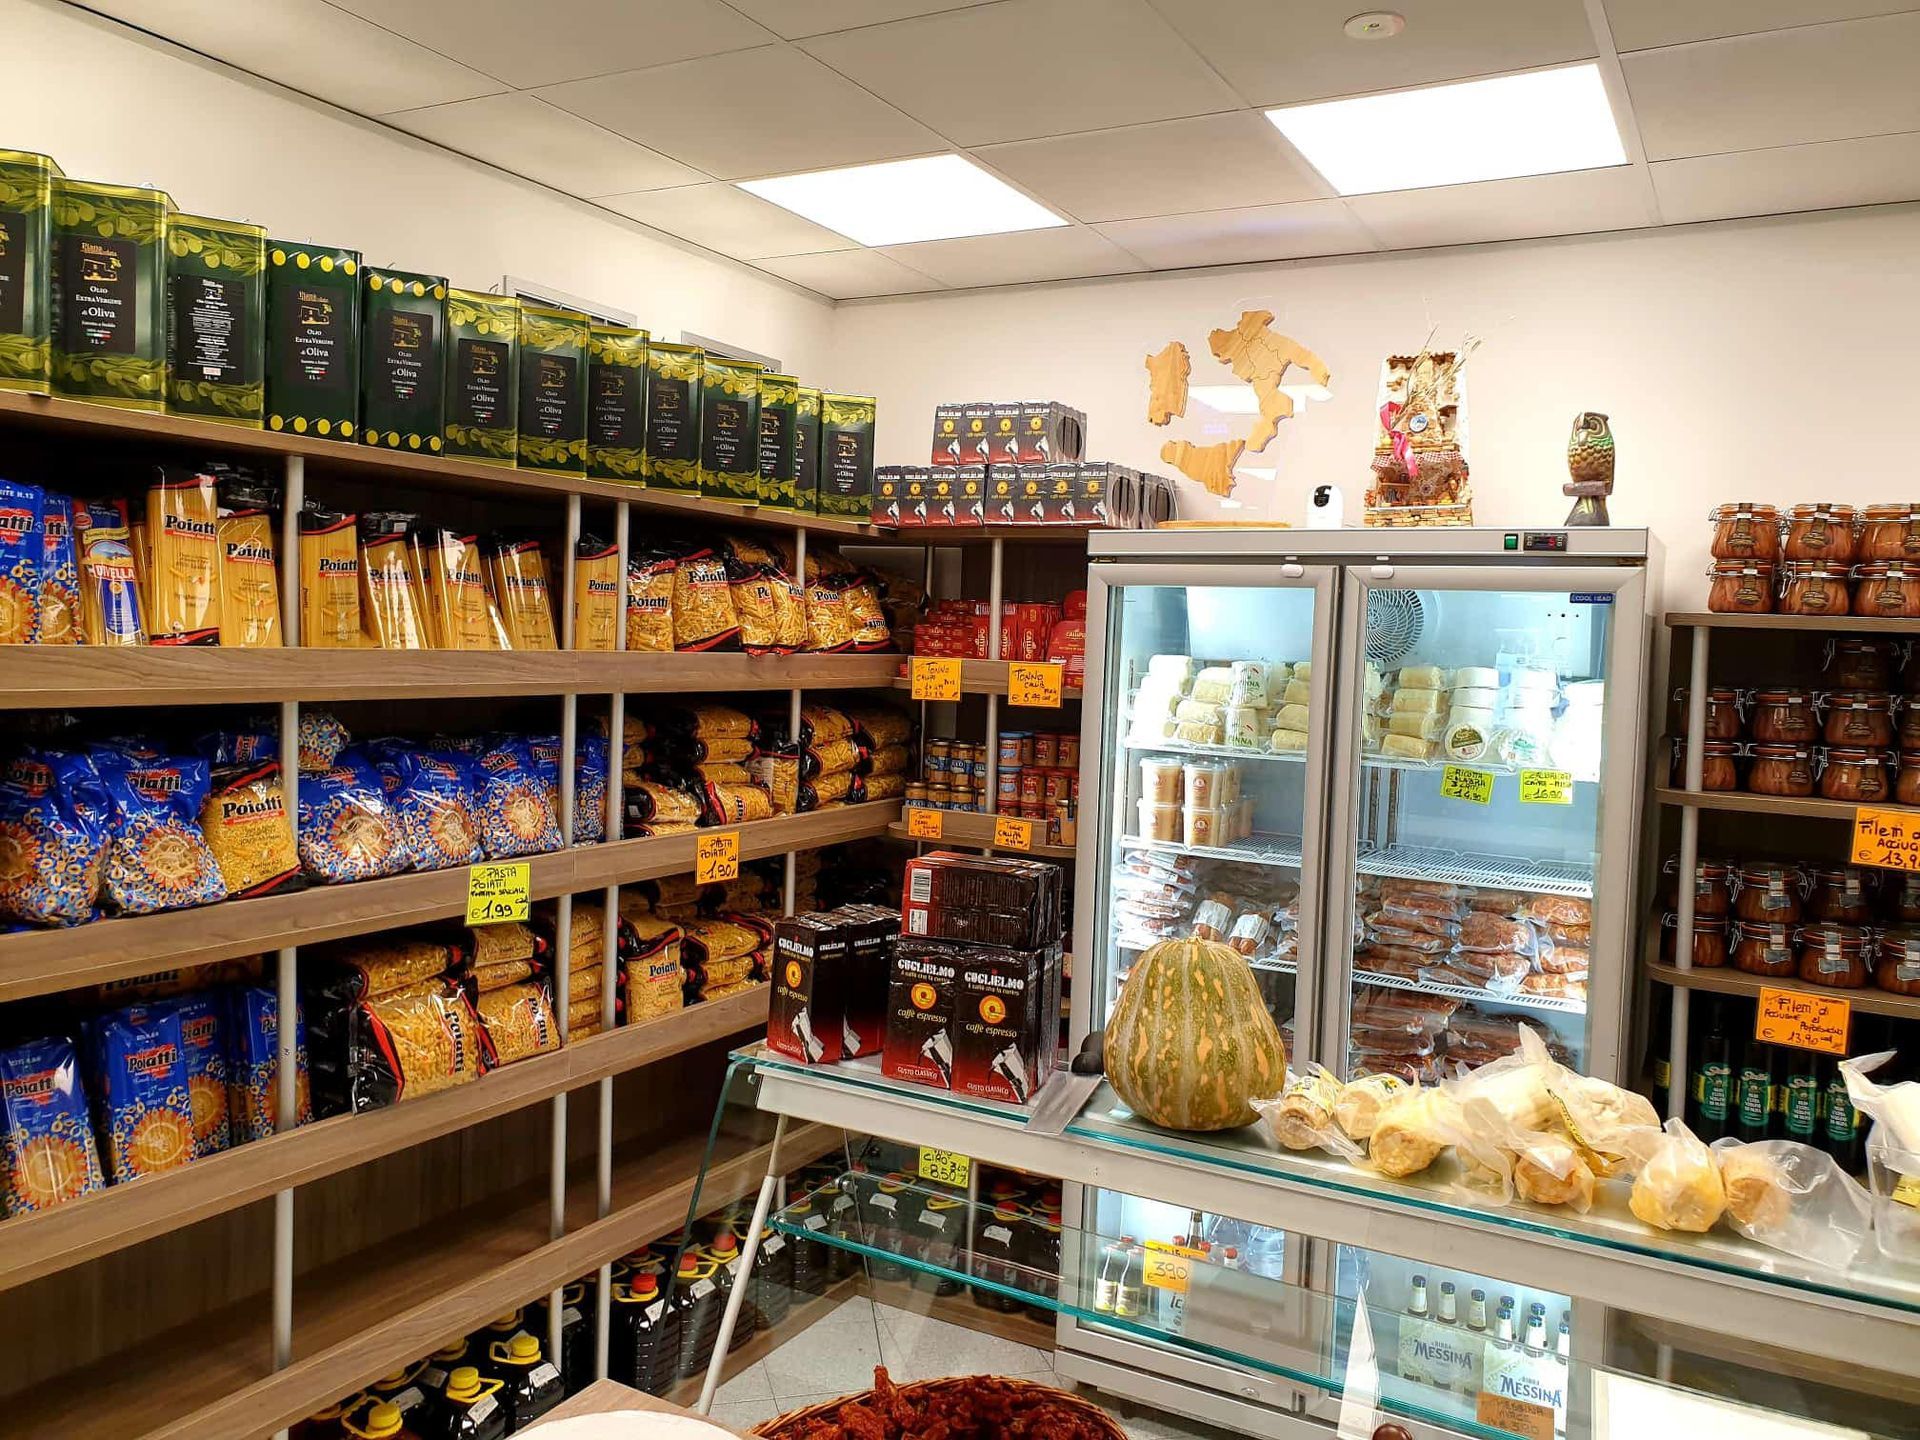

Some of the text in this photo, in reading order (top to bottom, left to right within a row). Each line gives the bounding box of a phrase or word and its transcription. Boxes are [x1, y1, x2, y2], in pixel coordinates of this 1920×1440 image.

[88, 306, 116, 319] Oliva
[306, 346, 329, 357] Oliva
[396, 368, 417, 378] Oliva
[476, 393, 495, 403] Oliva
[544, 405, 563, 415] Oliva
[626, 594, 669, 608] Poiatti
[222, 796, 283, 819] Poiatti
[1858, 849, 1873, 861] €
[486, 866, 517, 878] PASTA
[778, 937, 814, 958] GUGLIELMO
[897, 958, 955, 979] GUGLIELMO
[964, 971, 1024, 991] GUGLIELMO
[897, 1008, 948, 1024] caffè espresso
[965, 1023, 1017, 1039] caffè espresso
[1762, 1028, 1776, 1039] €
[128, 1049, 177, 1072] Poiatti
[897, 1066, 938, 1081] GUSTO CLASSICO
[966, 1082, 1009, 1095] GUSTO CLASSICO
[1413, 1339, 1473, 1370] MESSINA
[1500, 1373, 1563, 1409] MESSINA
